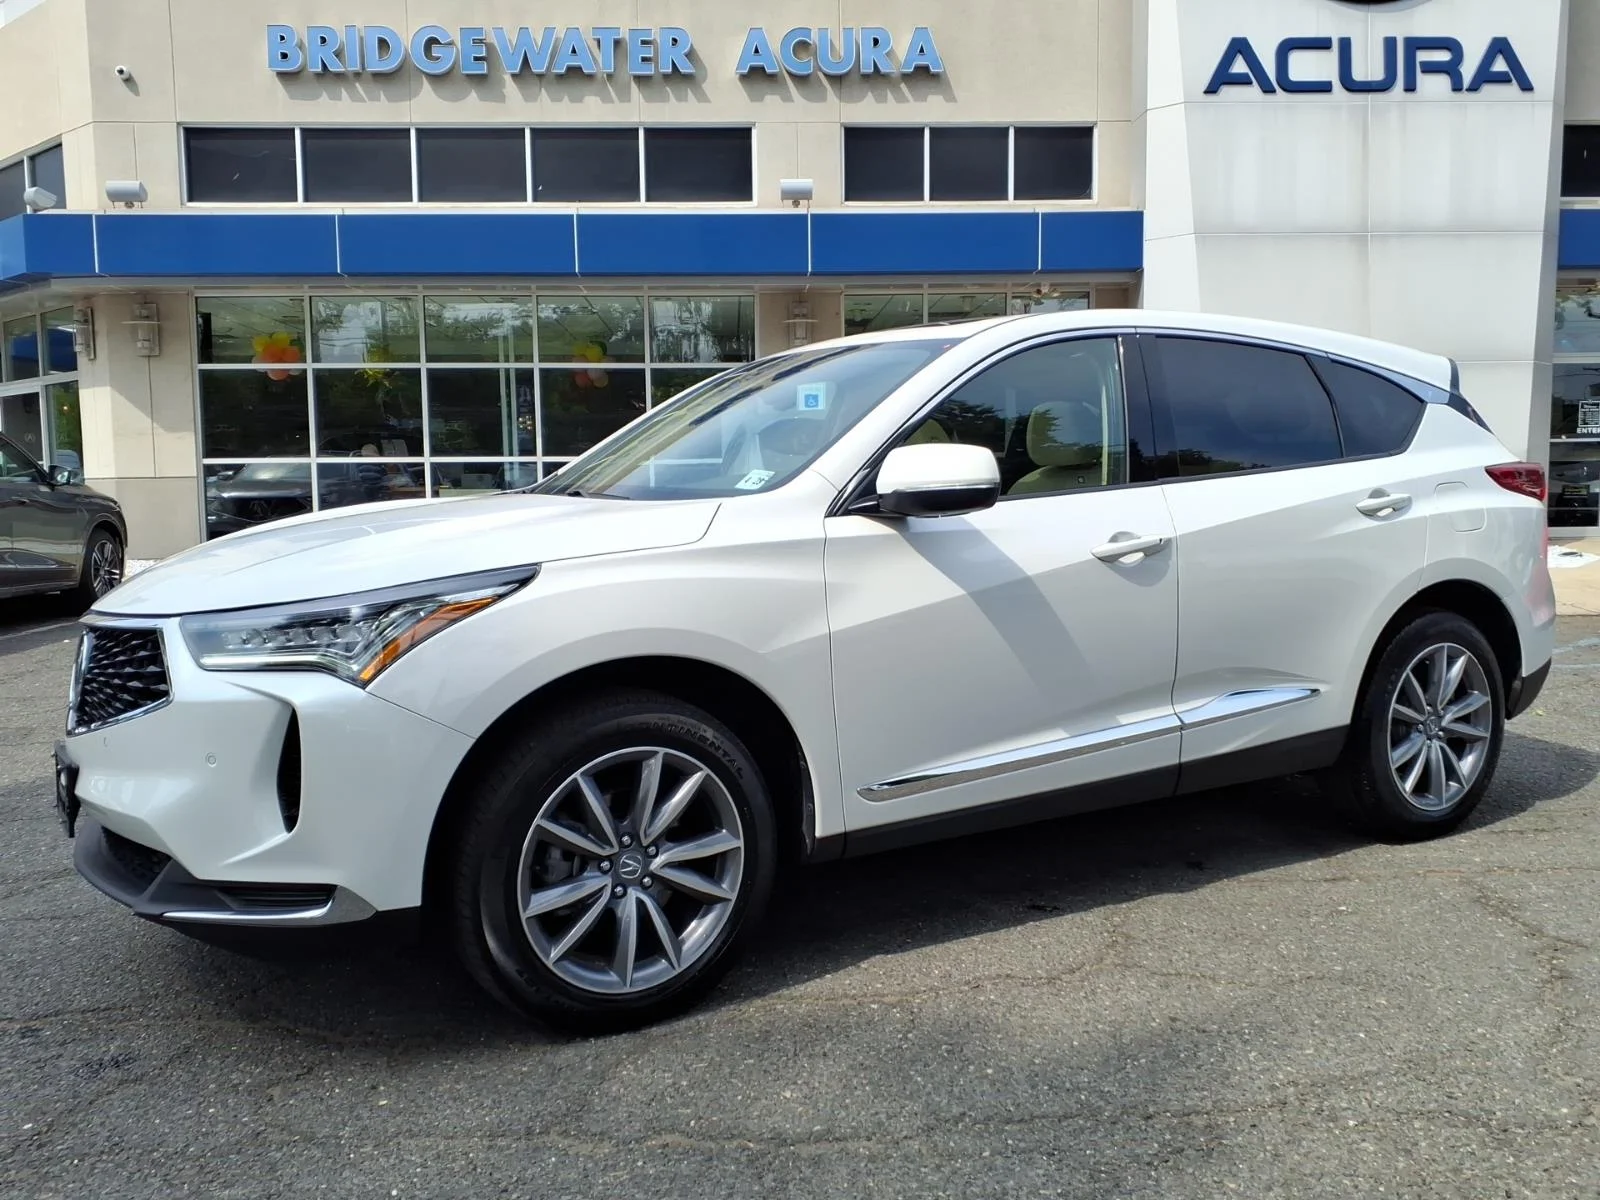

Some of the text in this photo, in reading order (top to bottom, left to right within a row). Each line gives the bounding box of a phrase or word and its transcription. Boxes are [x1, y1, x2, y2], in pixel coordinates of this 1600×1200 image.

[266, 24, 945, 77] BRIDGEWATER ACURA
[1203, 36, 1535, 94] ACURA
[627, 720, 744, 780] NTINENTAL
